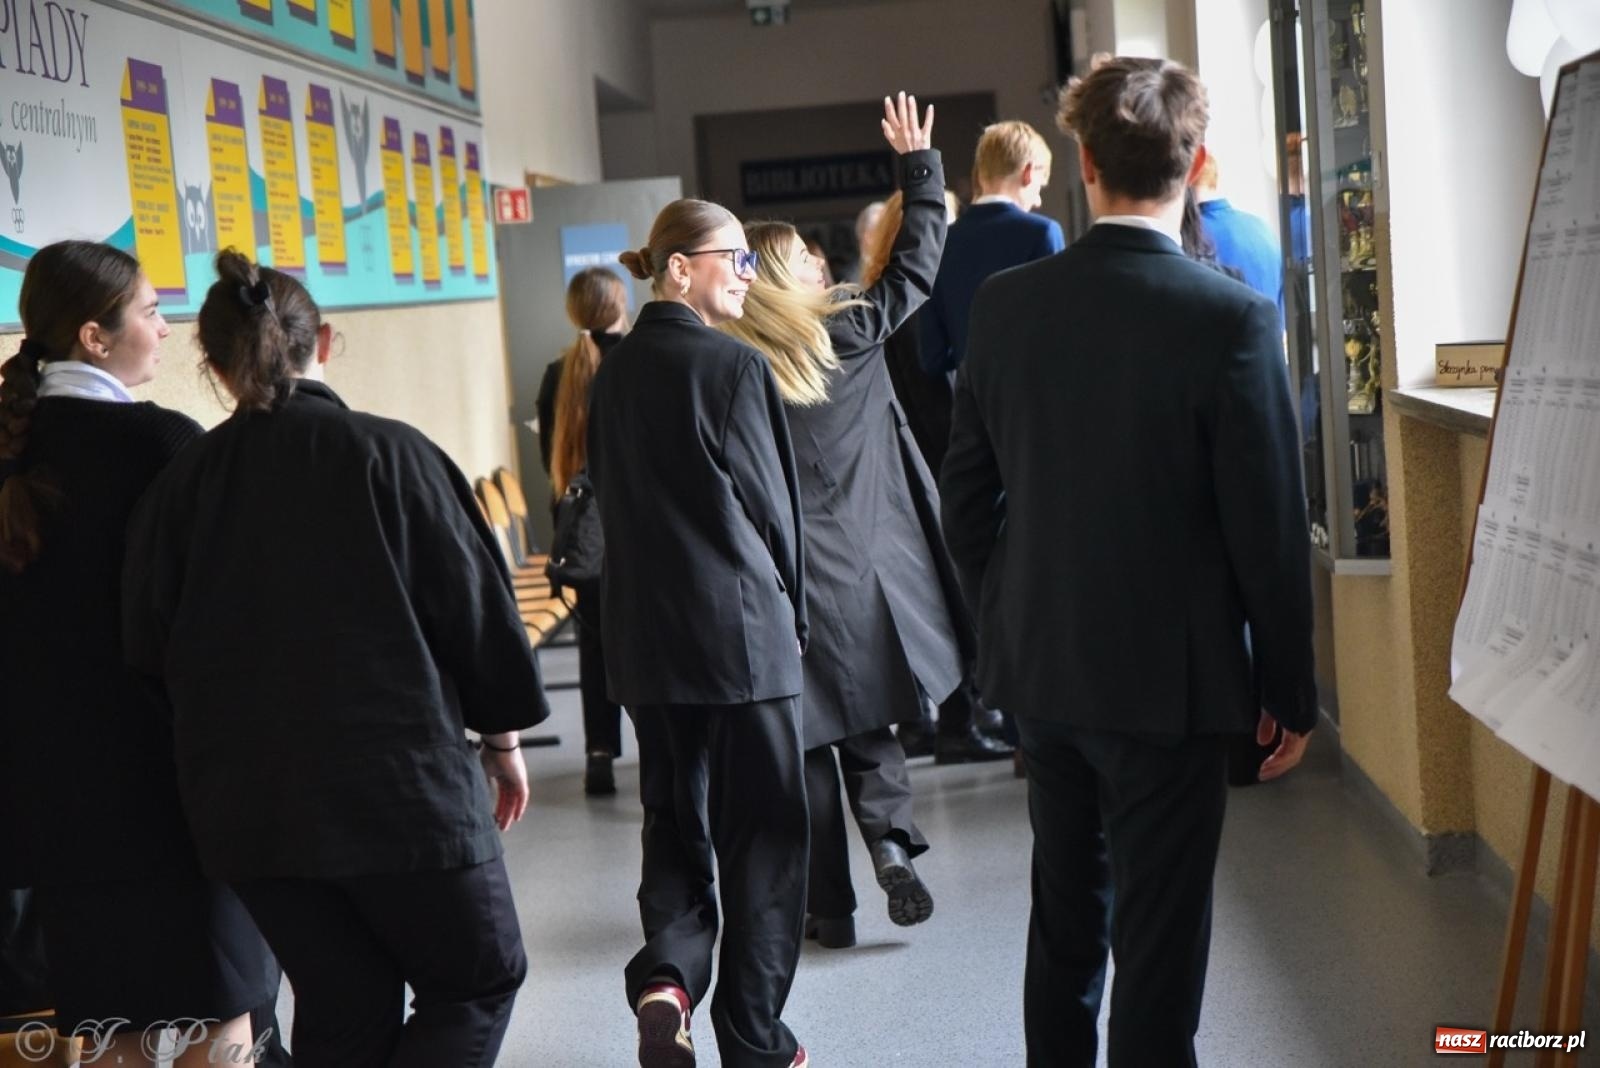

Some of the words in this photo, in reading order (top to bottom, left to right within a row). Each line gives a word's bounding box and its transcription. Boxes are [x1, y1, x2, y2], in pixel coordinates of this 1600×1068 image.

[11, 98, 98, 152] centralnym
[745, 163, 890, 197] BIBLIOTEKA
[1438, 360, 1477, 381] Skrzynka
